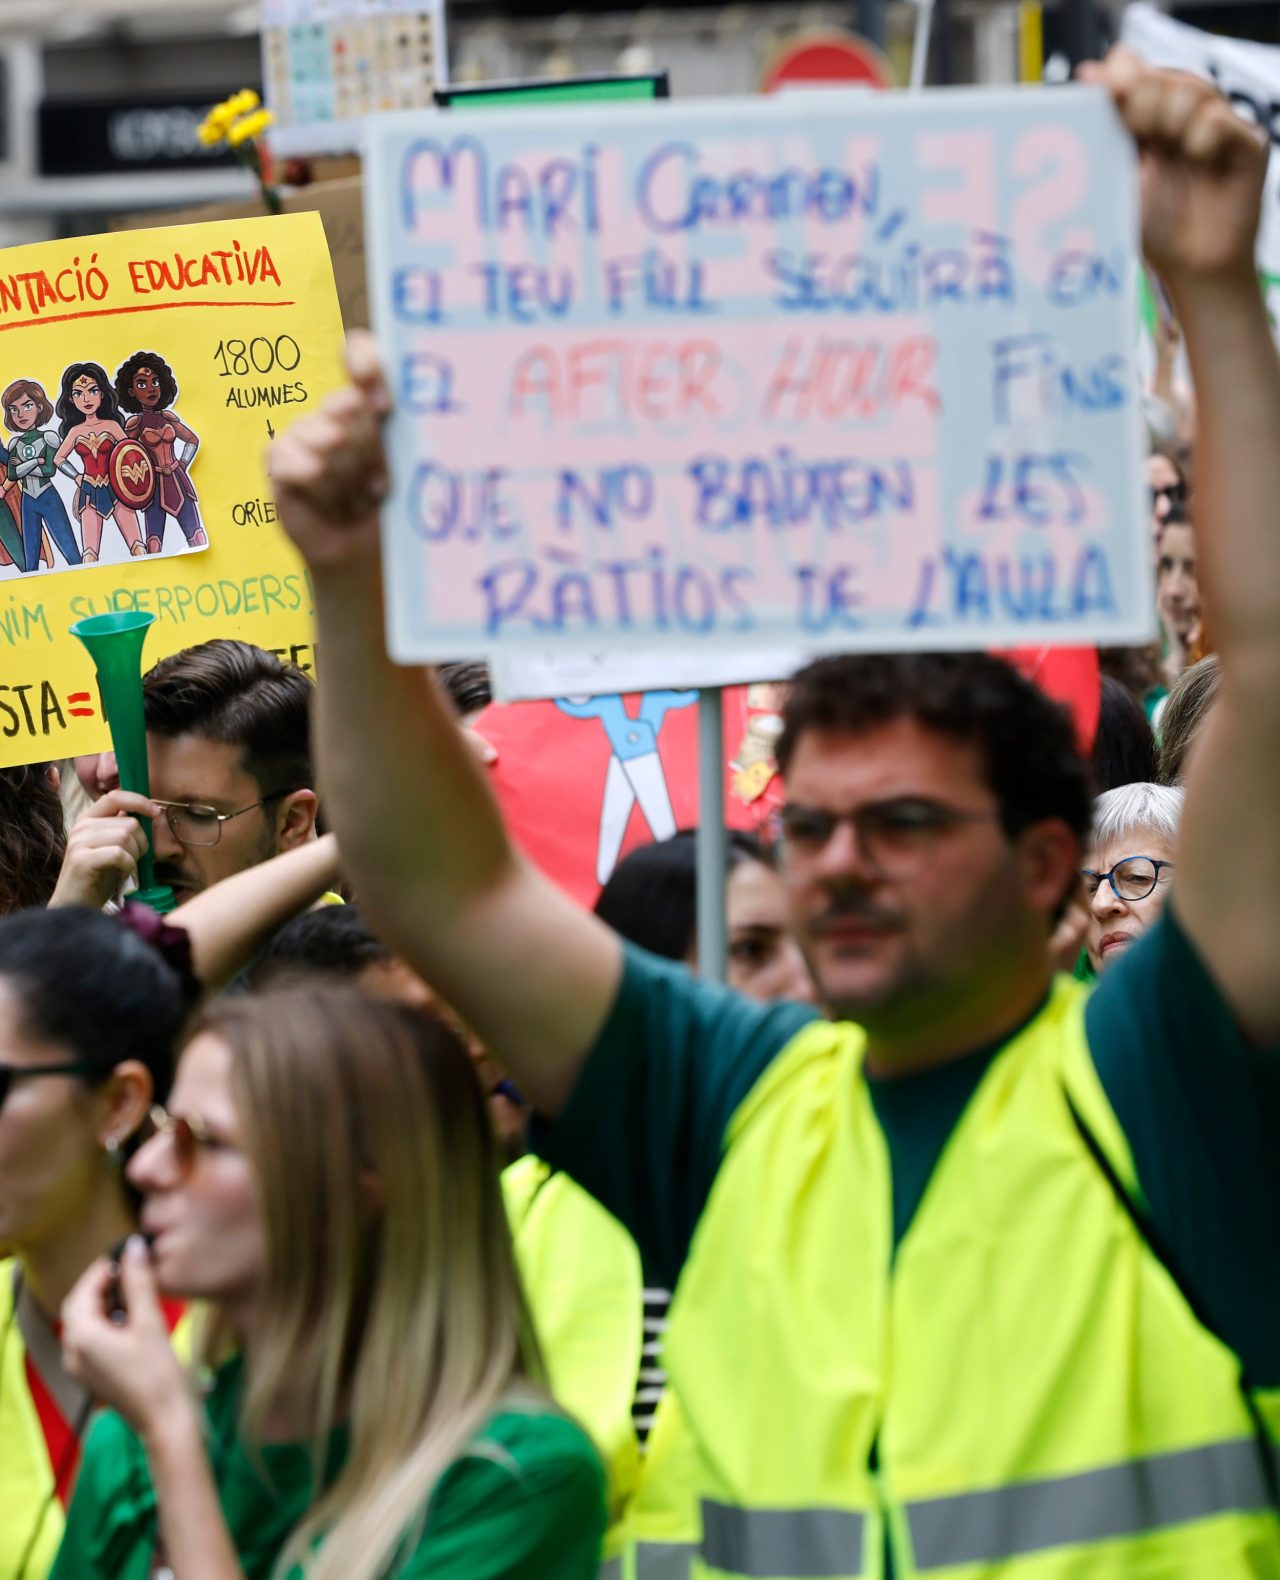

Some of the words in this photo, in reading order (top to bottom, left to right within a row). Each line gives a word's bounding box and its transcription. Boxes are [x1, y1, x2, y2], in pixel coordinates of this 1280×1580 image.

[128, 240, 282, 294] EDUCATIVA
[468, 256, 575, 328] TEU
[214, 335, 301, 376] 1800
[508, 336, 721, 421] AFTER
[760, 334, 942, 420] HOUR
[226, 382, 308, 409] ALUMNES
[232, 499, 280, 528] ORIE
[405, 456, 522, 543] QUE
[557, 460, 656, 533] NO
[976, 449, 1093, 527] LES
[794, 560, 867, 636] DE
